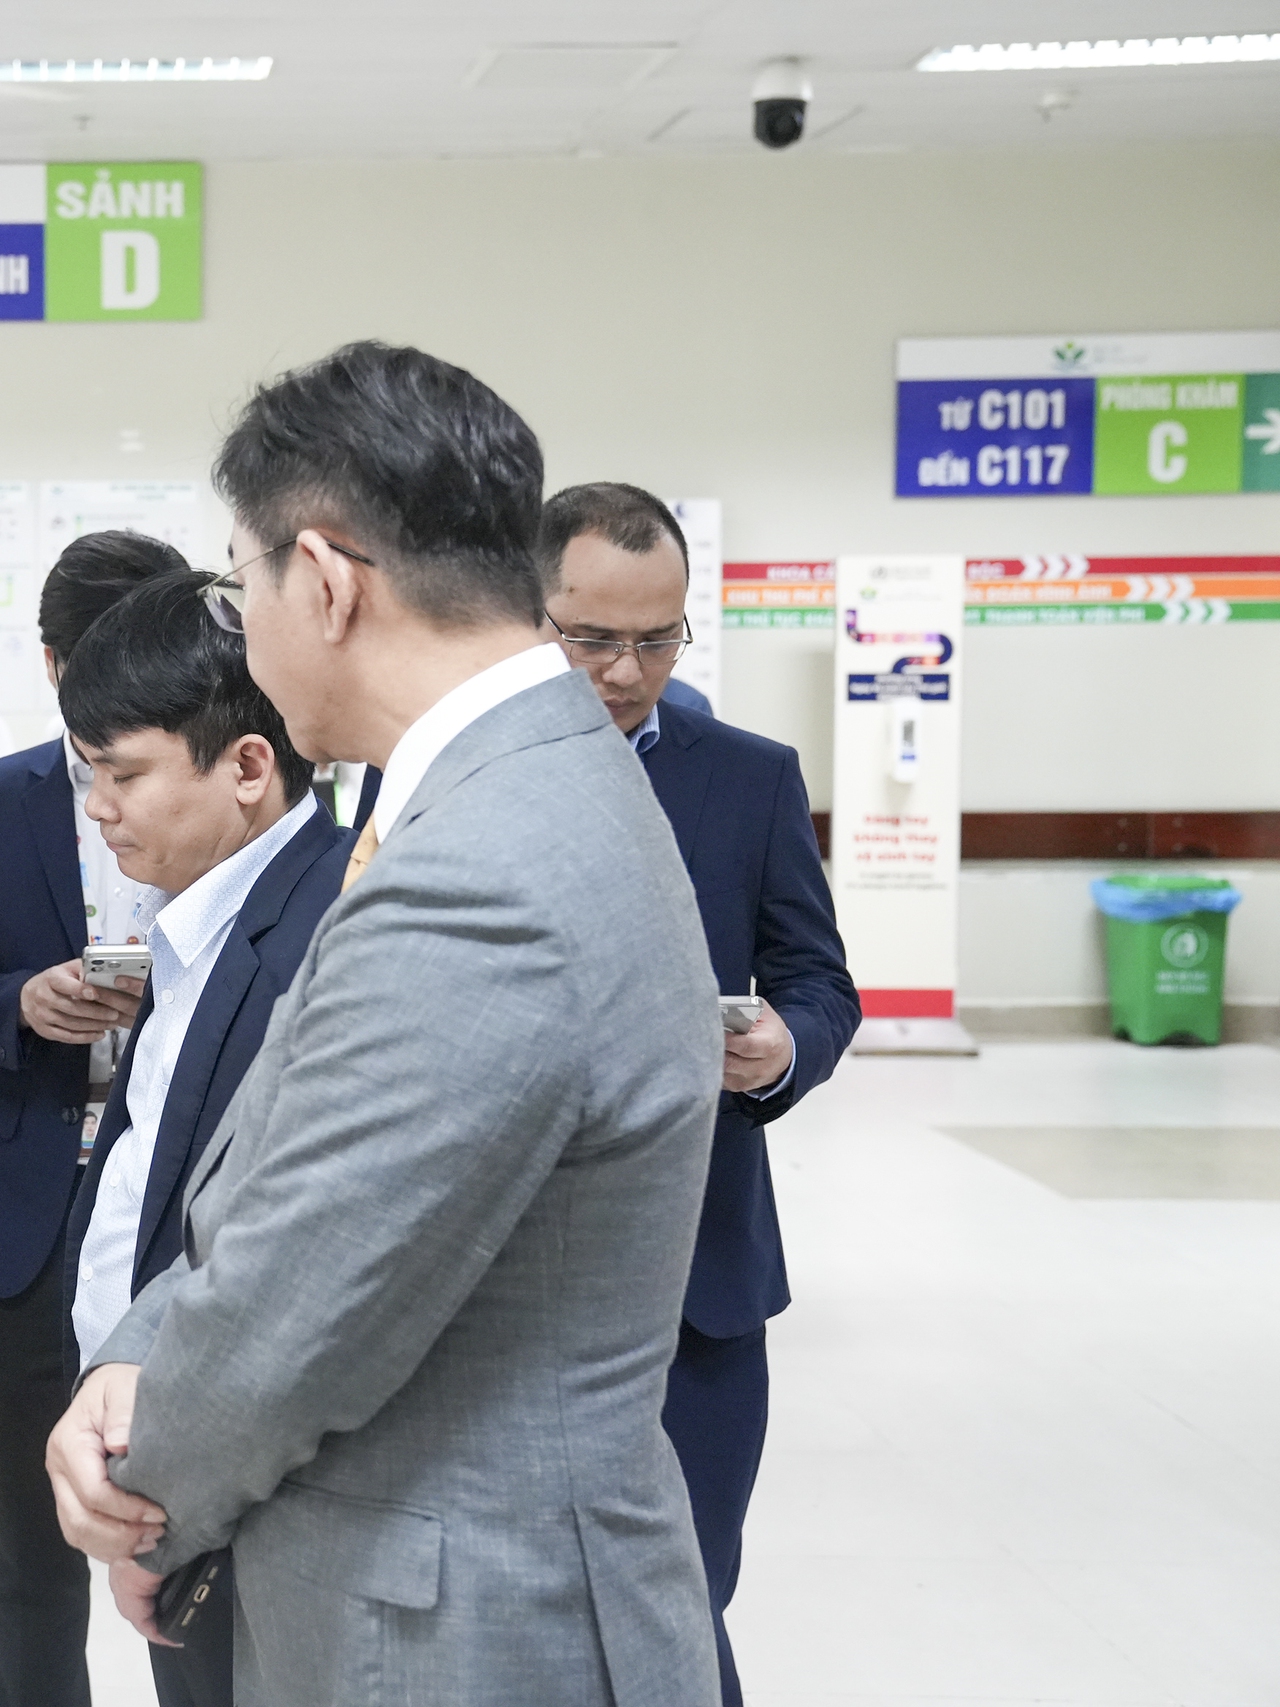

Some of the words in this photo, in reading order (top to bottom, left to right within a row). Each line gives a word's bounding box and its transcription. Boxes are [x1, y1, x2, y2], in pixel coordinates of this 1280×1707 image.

[56, 171, 185, 218] SẢNH
[100, 230, 161, 310] D
[939, 396, 974, 430] TỪ
[978, 388, 1066, 430] C101
[918, 448, 971, 487] ĐẾN
[976, 445, 1070, 487] C117
[1148, 421, 1188, 483] C
